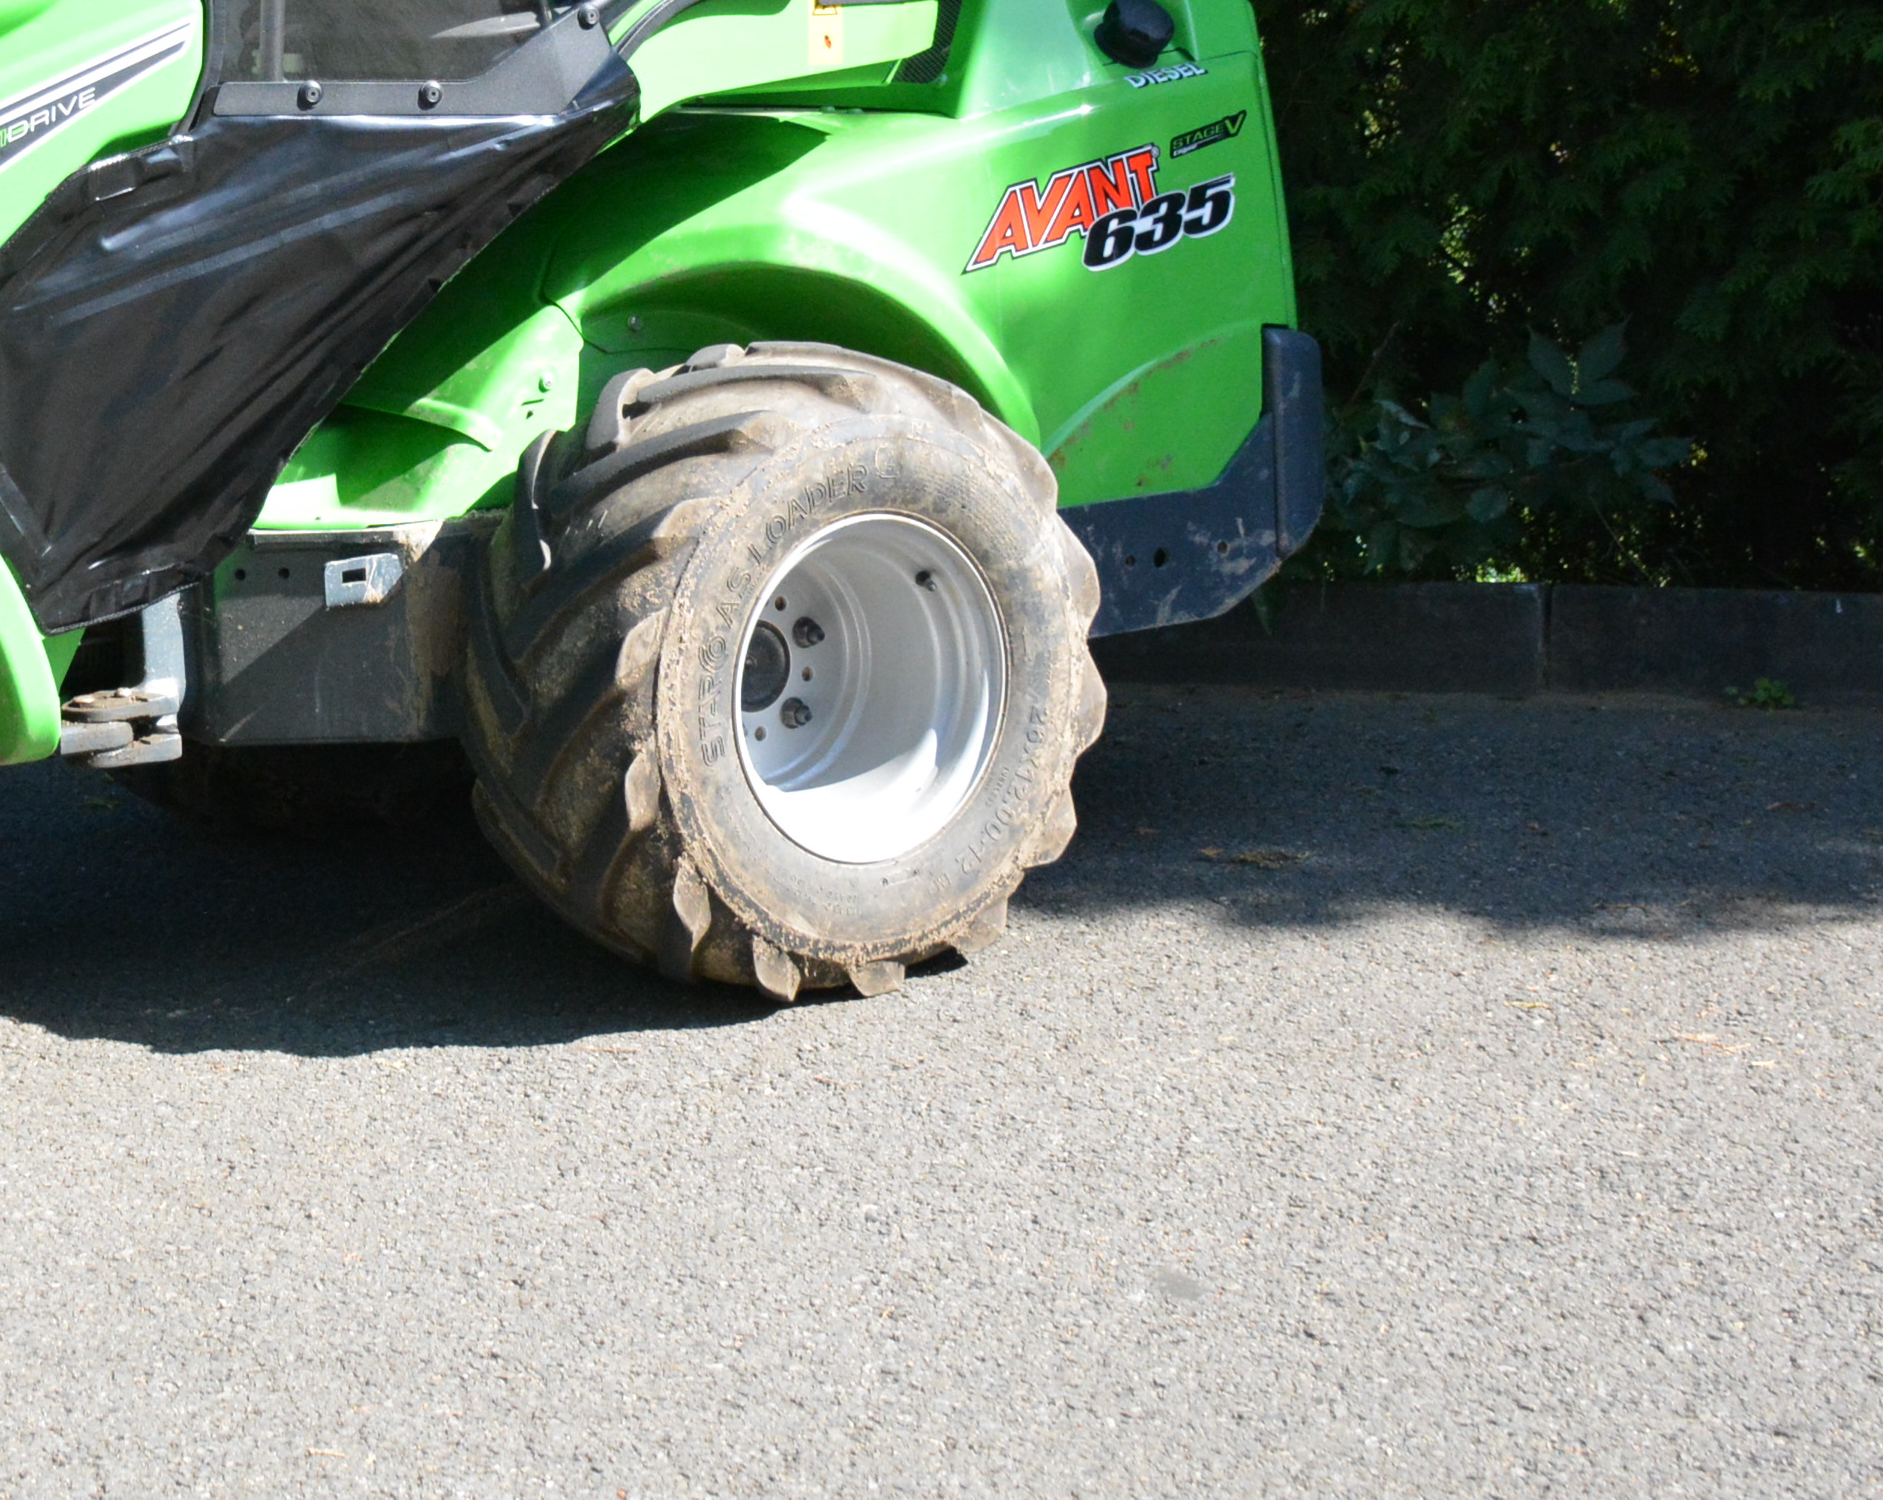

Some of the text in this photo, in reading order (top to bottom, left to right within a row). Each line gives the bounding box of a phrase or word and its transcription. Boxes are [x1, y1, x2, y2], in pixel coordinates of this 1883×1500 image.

[1123, 62, 1208, 88] DIESEL
[1172, 122, 1225, 151] STAGE
[1224, 112, 1245, 135] V
[966, 145, 1157, 273] AVANT
[1083, 173, 1235, 271] 635
[748, 462, 868, 566] LOADER
